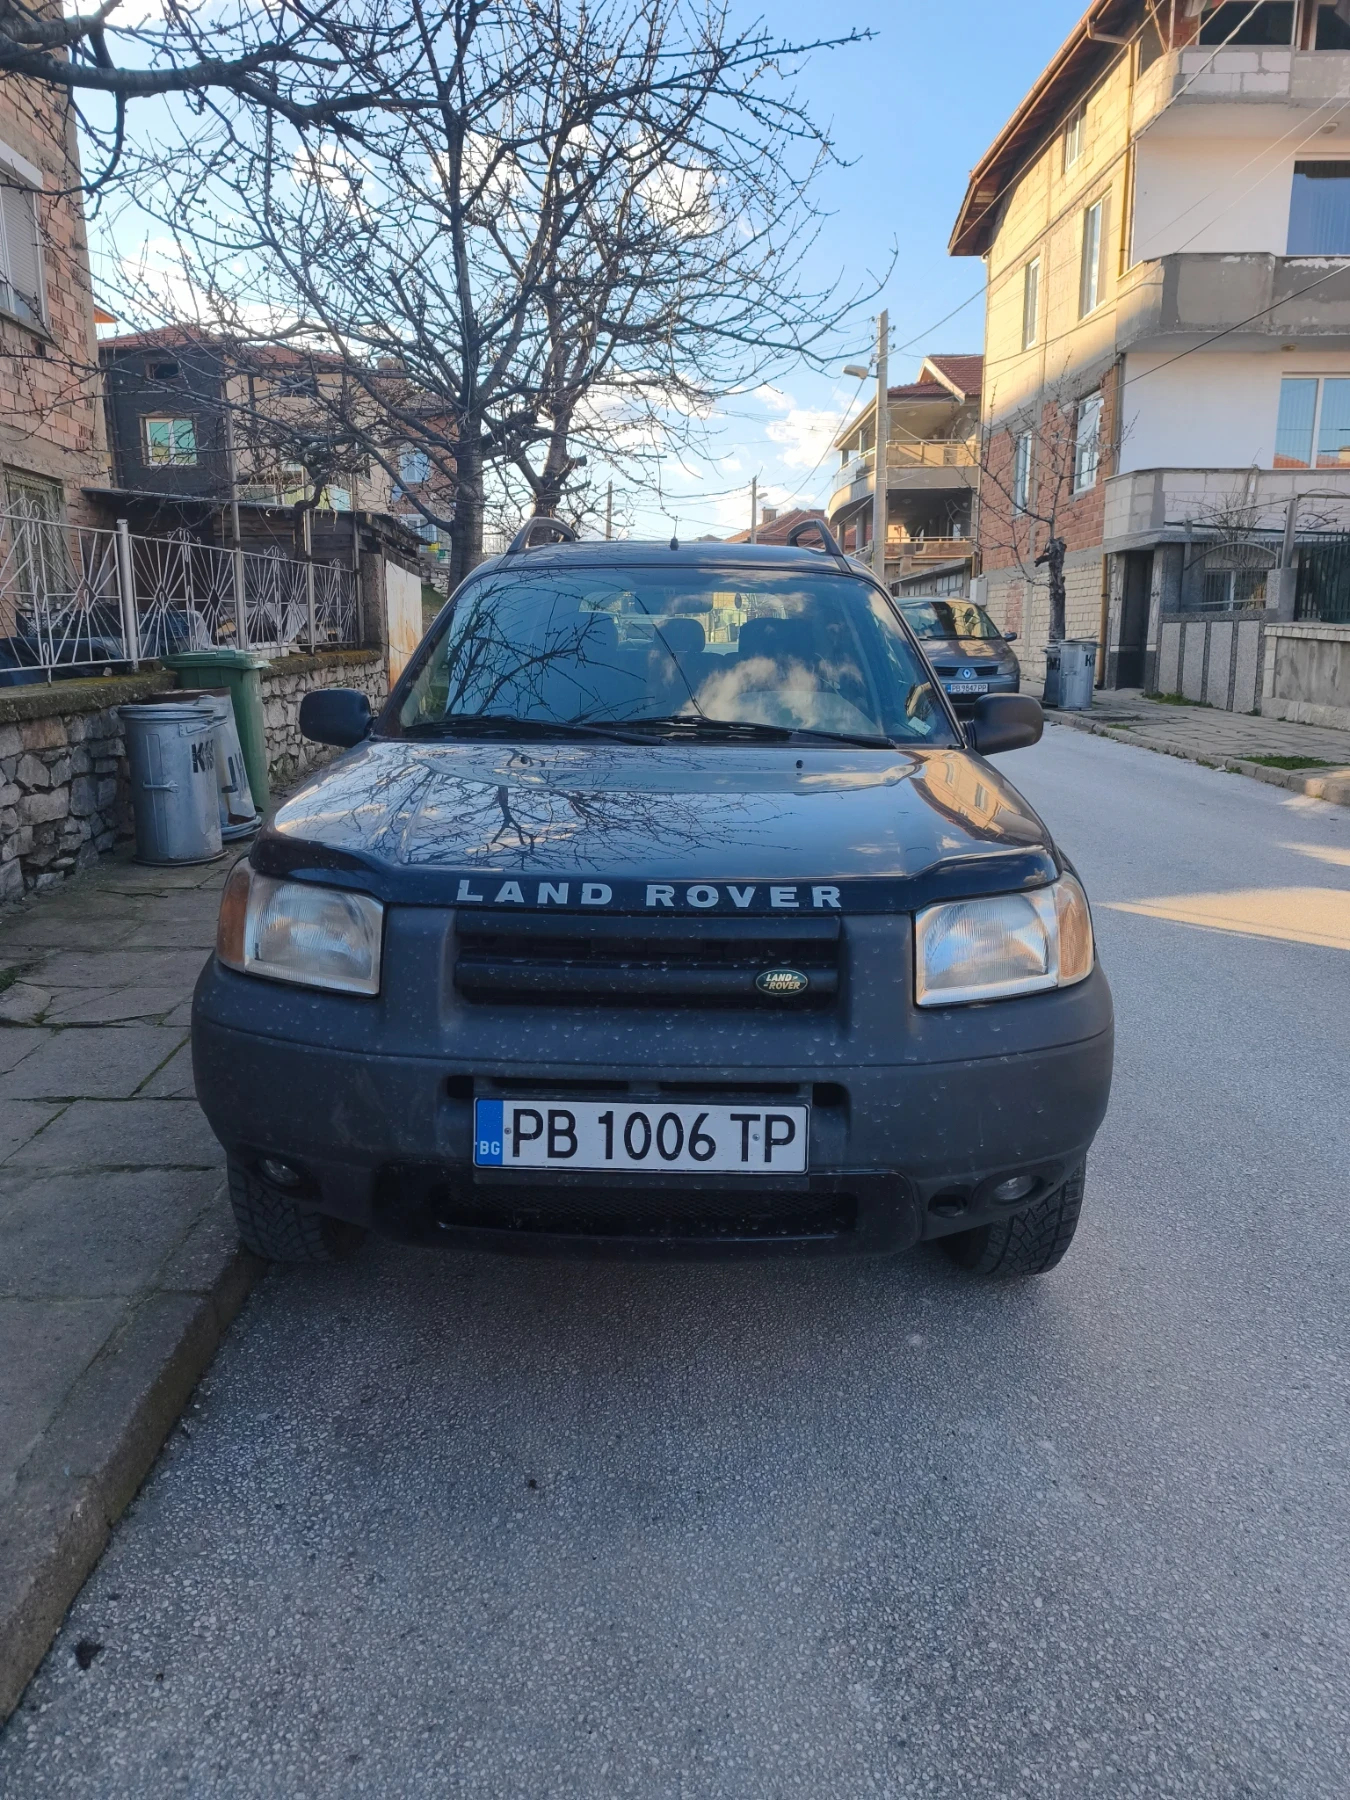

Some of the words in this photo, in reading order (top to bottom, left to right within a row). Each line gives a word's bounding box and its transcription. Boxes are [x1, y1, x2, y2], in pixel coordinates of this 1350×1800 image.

[952, 684, 961, 692] PB
[977, 684, 987, 692] PP
[456, 879, 613, 905] LAND
[645, 884, 842, 908] ROVER
[765, 973, 793, 982] LAND
[768, 981, 801, 990] ROVER
[512, 1108, 578, 1159] PB
[598, 1110, 717, 1162] 1006
[730, 1113, 796, 1163] TP
[479, 1141, 500, 1155] BG
